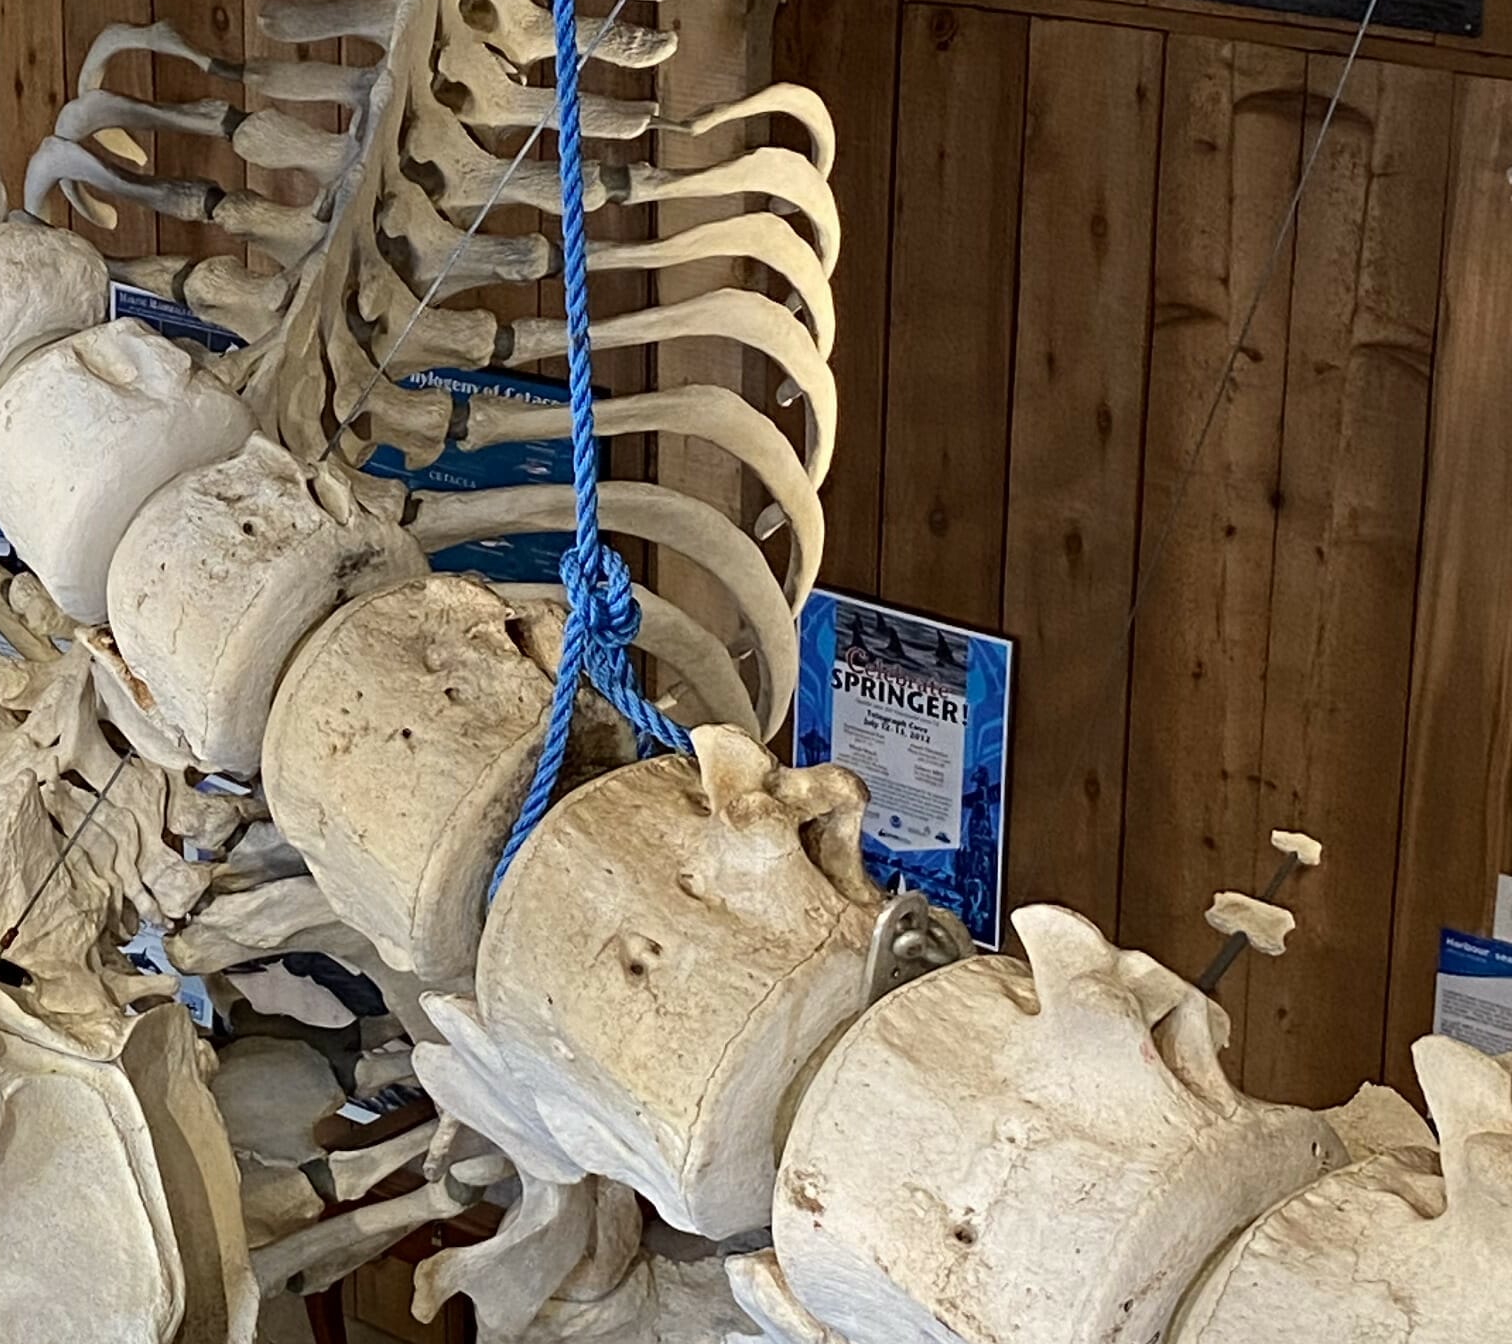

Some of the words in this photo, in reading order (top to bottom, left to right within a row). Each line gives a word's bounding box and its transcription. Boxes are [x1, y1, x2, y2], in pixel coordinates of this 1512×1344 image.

[409, 371, 478, 395] hylogeny
[845, 646, 950, 699] Celebrate
[831, 668, 969, 726] SPRINGER!
[867, 709, 906, 728] Telegraph
